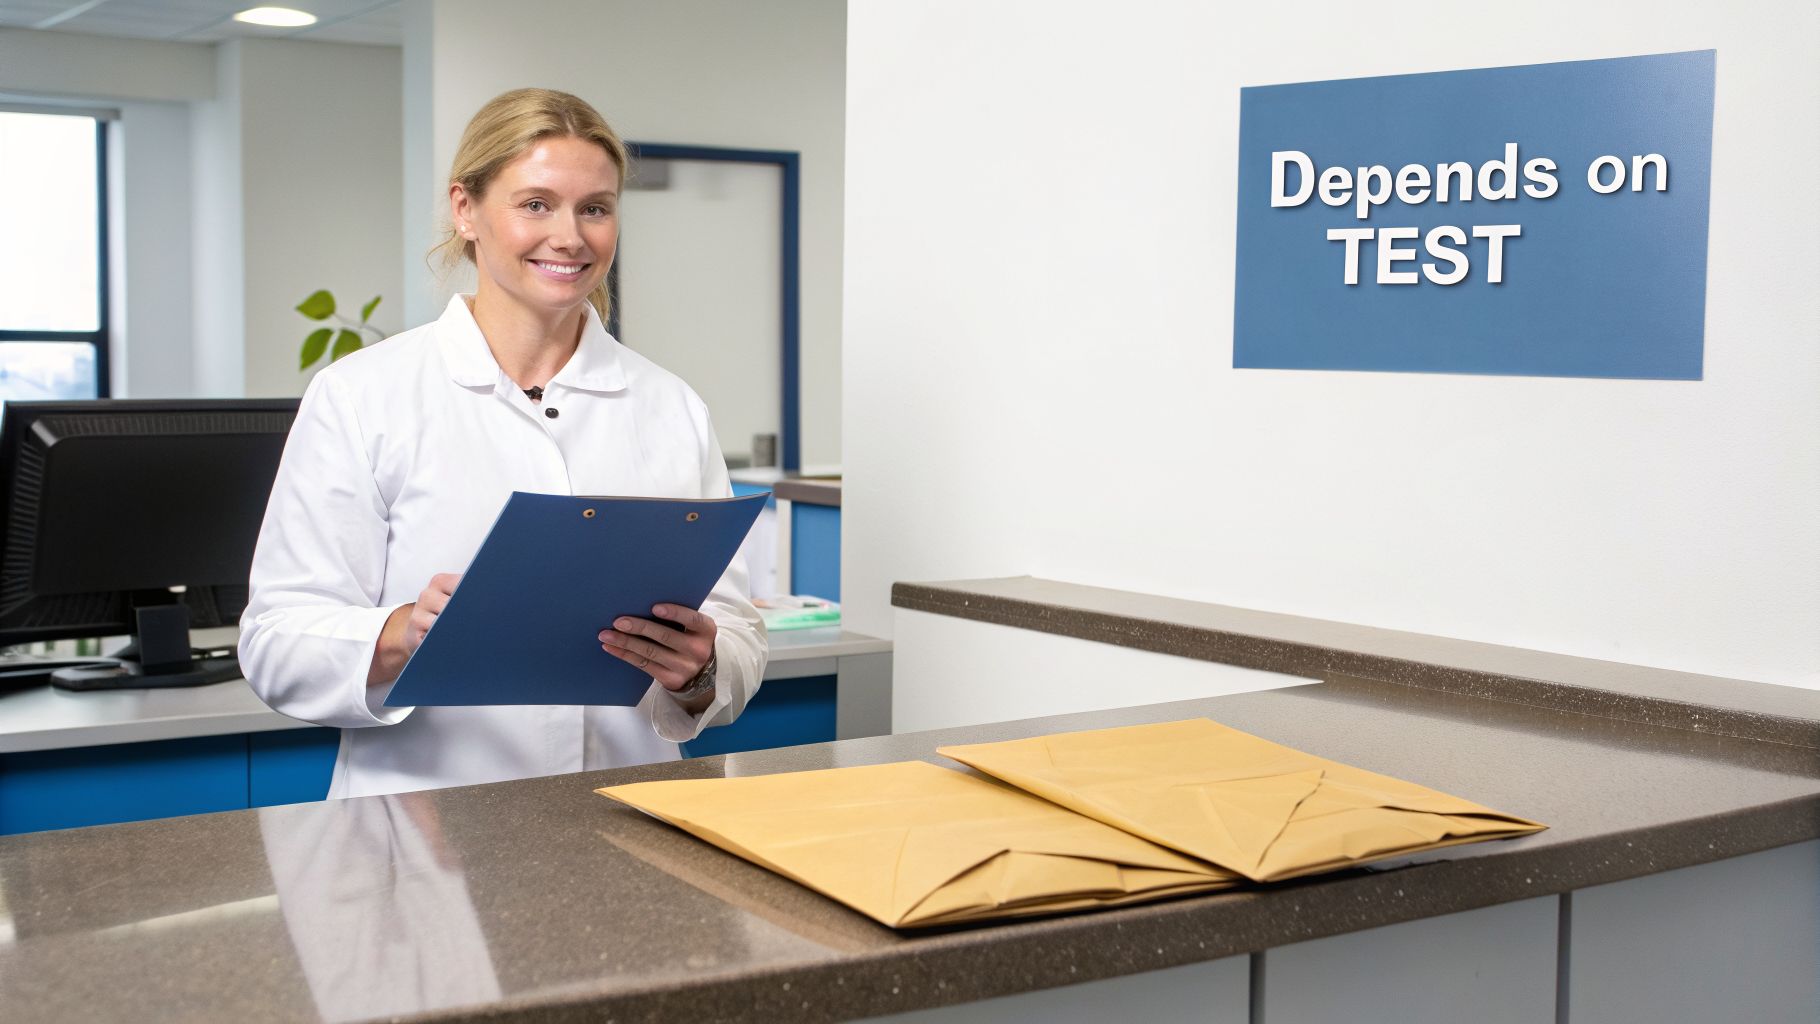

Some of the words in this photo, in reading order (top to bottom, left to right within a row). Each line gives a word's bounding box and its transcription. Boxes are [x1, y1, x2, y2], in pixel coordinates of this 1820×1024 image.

[1270, 143, 1559, 219] Depends
[1587, 153, 1668, 195] on
[1326, 224, 1522, 286] TEST
